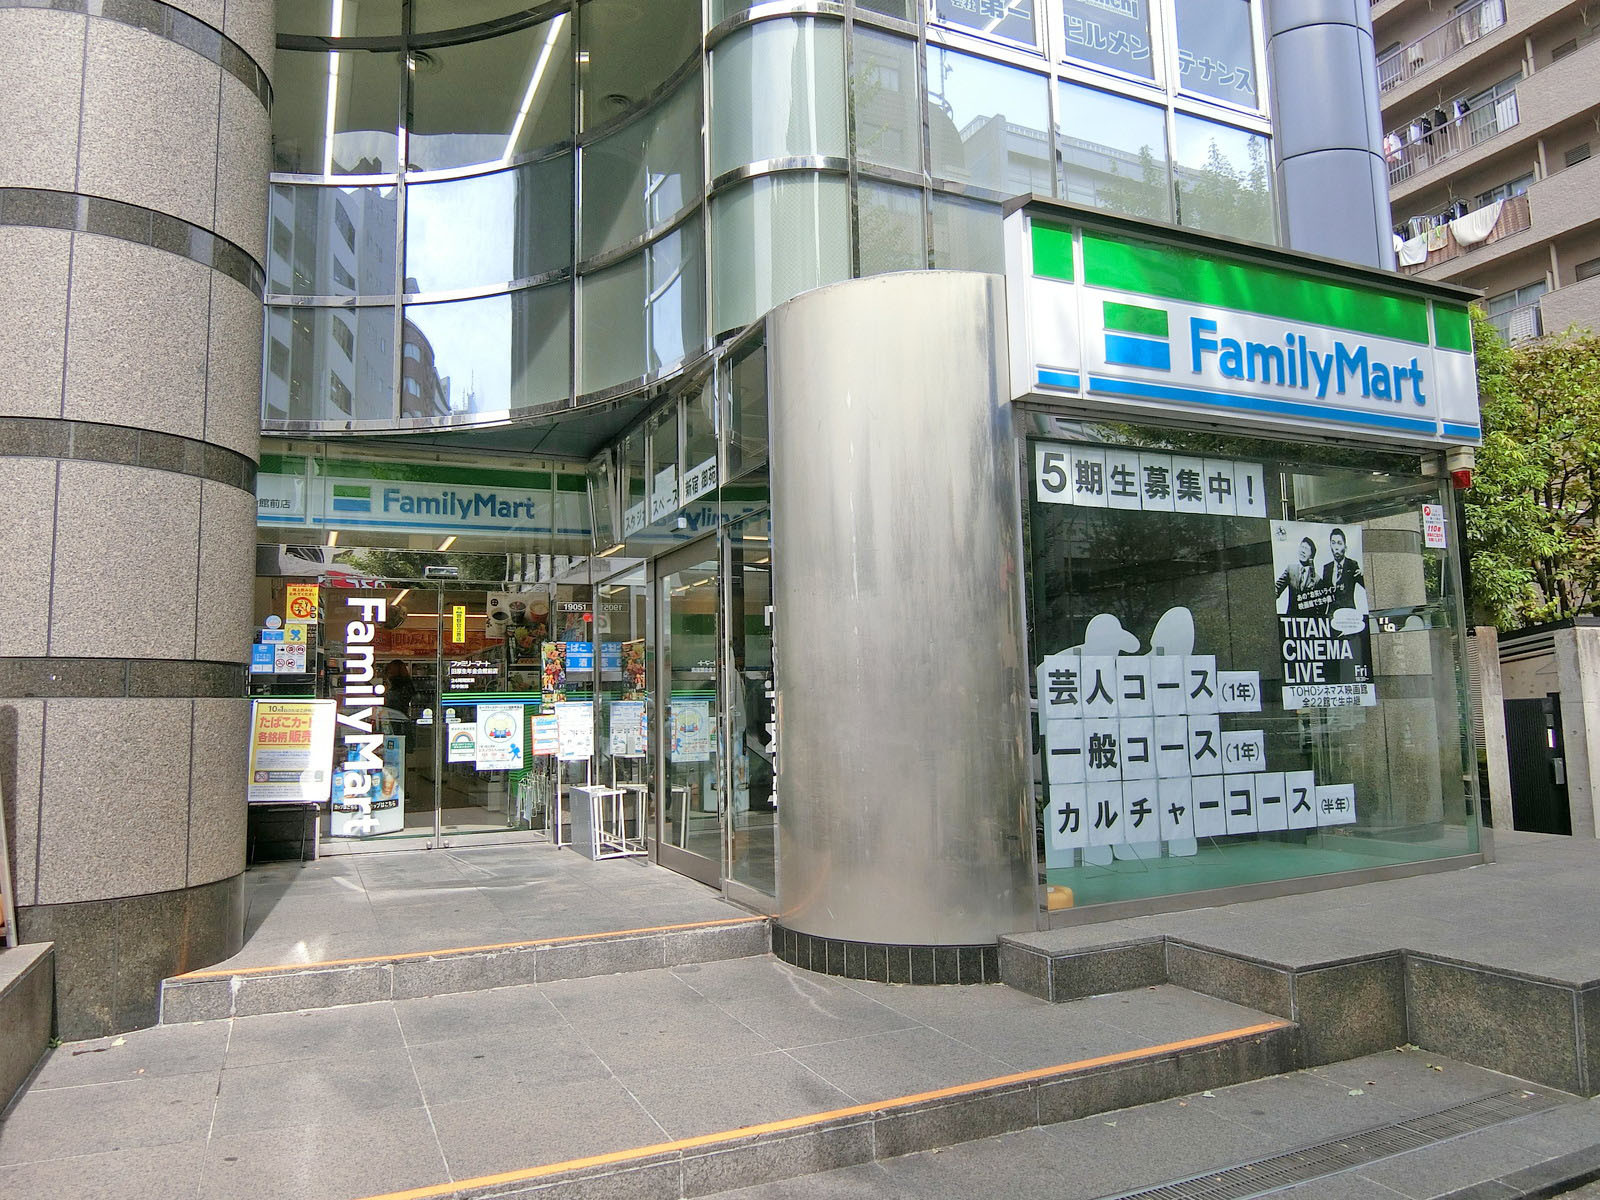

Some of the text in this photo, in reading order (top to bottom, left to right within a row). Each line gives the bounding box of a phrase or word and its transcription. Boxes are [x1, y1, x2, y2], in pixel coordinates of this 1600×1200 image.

[1063, 14, 1255, 95] ビルメン テナンス
[1189, 316, 1426, 406] FamilyMart
[383, 487, 535, 520] FamilyMart
[563, 603, 587, 611] 19051
[1280, 617, 1331, 638] TITAN
[1282, 639, 1353, 661] CINEMA
[1047, 668, 1256, 706] 芸人コース (1年)
[1283, 662, 1326, 684] LIVE
[1354, 665, 1368, 677] Fri
[336, 597, 386, 835] FamilyMart
[1050, 729, 1260, 770] 一般コース (1年)
[1057, 786, 1312, 834] カルチャーコース
